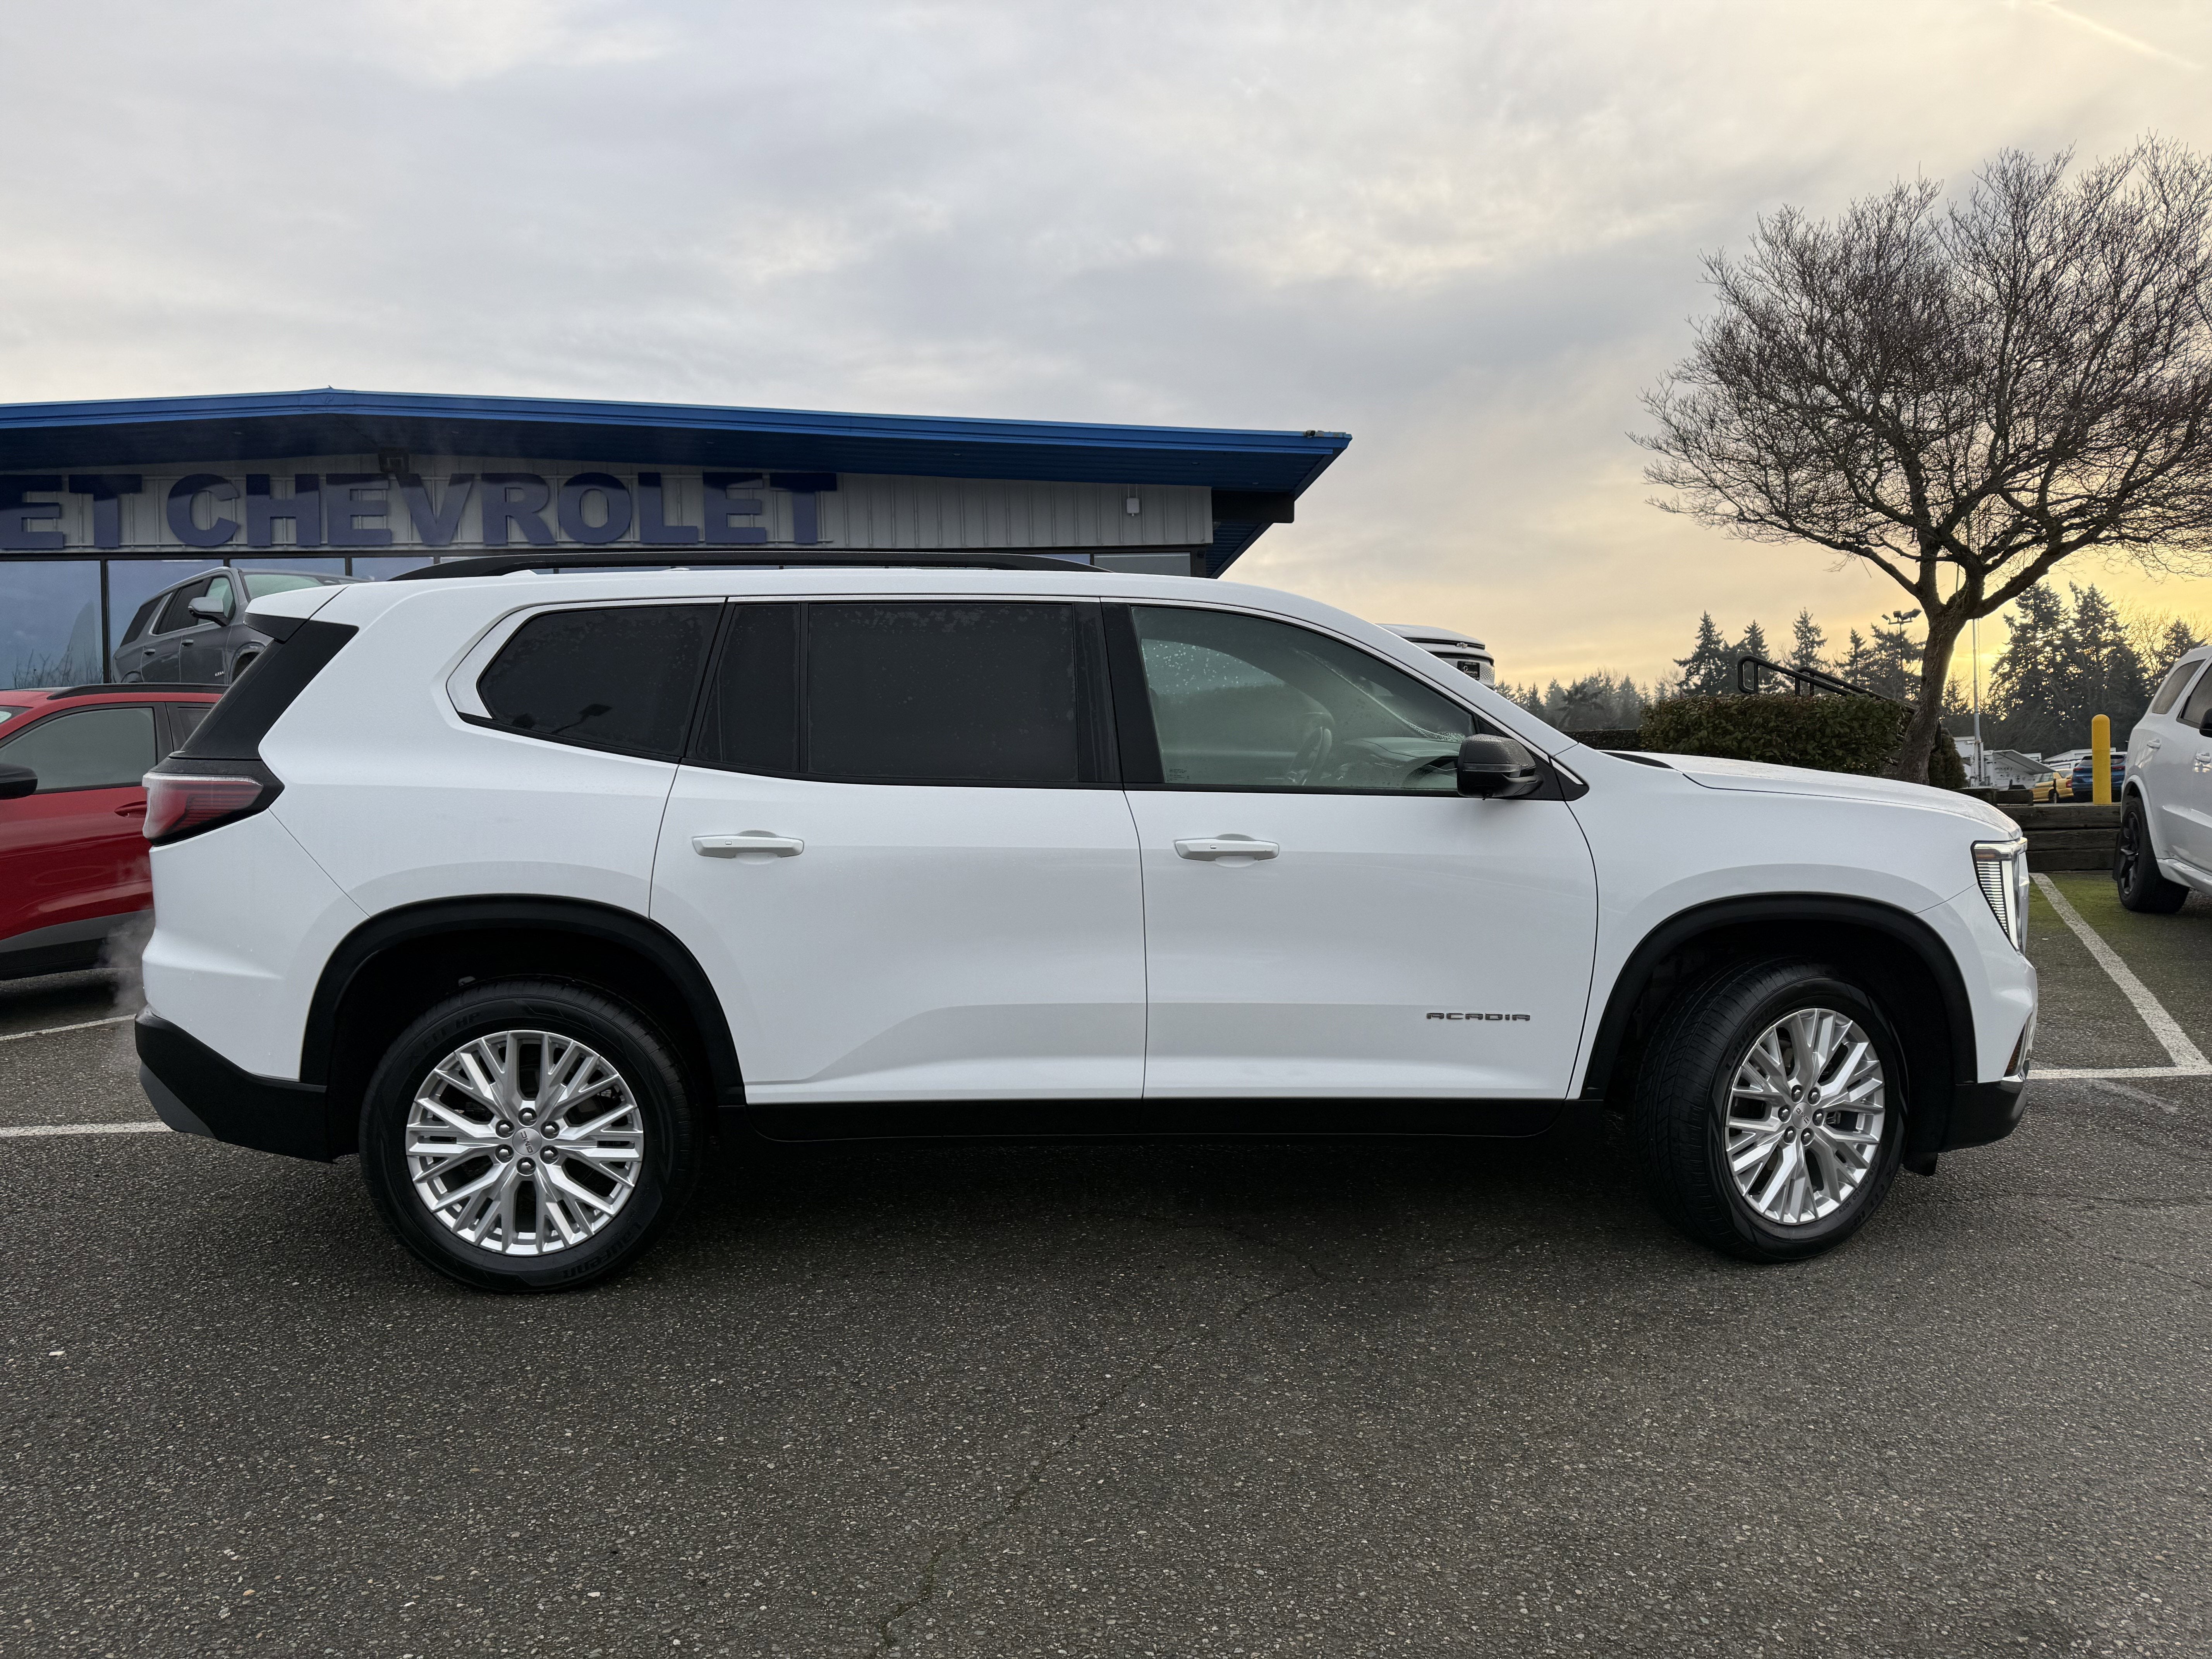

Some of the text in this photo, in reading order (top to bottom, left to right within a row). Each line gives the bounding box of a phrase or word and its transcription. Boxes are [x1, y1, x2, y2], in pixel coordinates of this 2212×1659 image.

[0, 472, 837, 549] ET CHEVROLET
[1426, 1012, 1530, 1021] ACADIA
[1796, 1108, 1809, 1123] GMC
[520, 1131, 533, 1153] GMC
